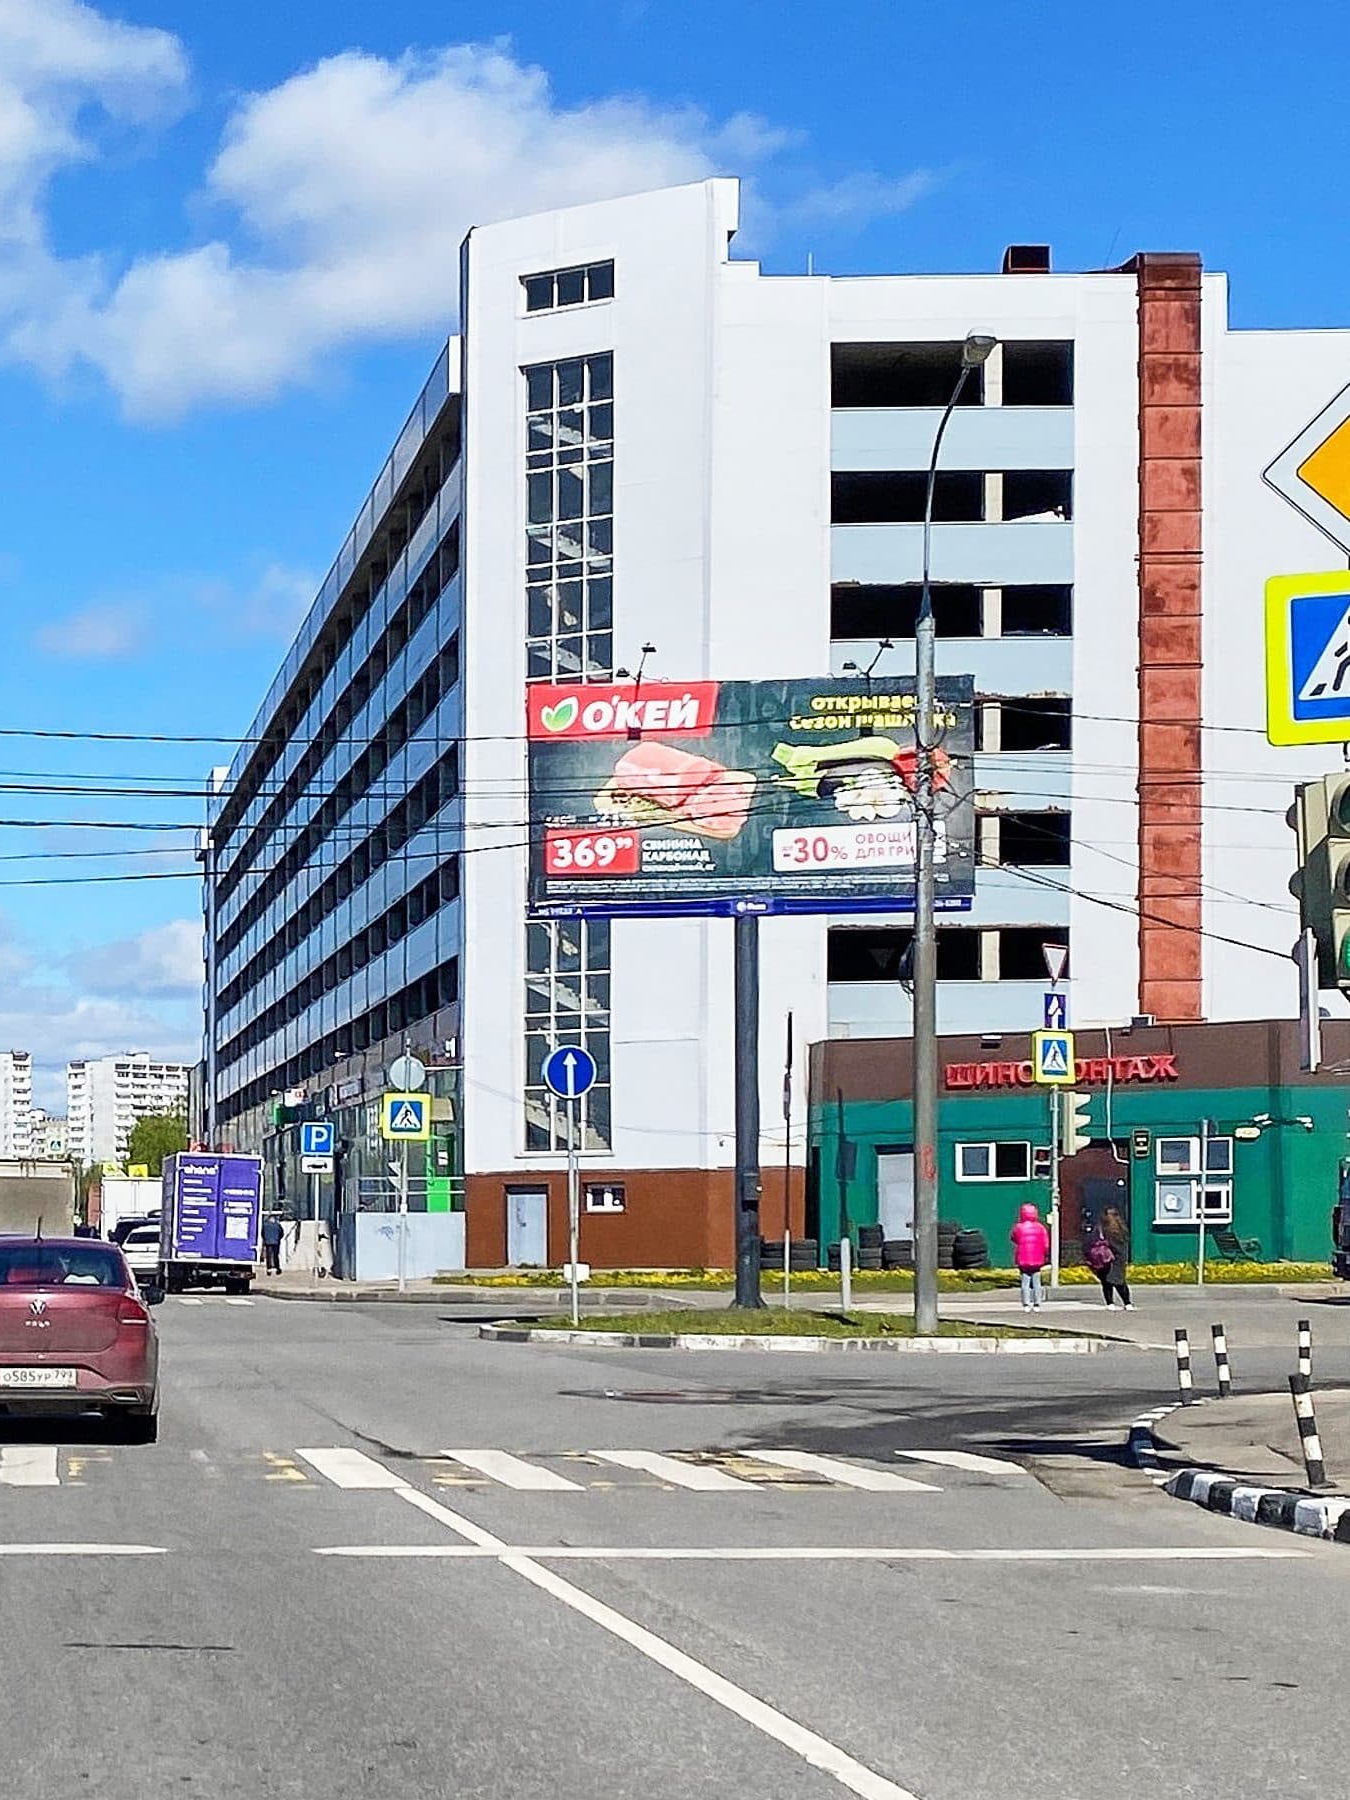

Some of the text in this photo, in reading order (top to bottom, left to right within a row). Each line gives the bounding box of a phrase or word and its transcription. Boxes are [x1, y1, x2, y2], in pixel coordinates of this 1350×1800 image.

[811, 695, 918, 713] открывае
[552, 837, 616, 867] 369
[889, 845, 916, 857] ГРИ
[946, 1054, 1179, 1090] ШИНООНТАЖ
